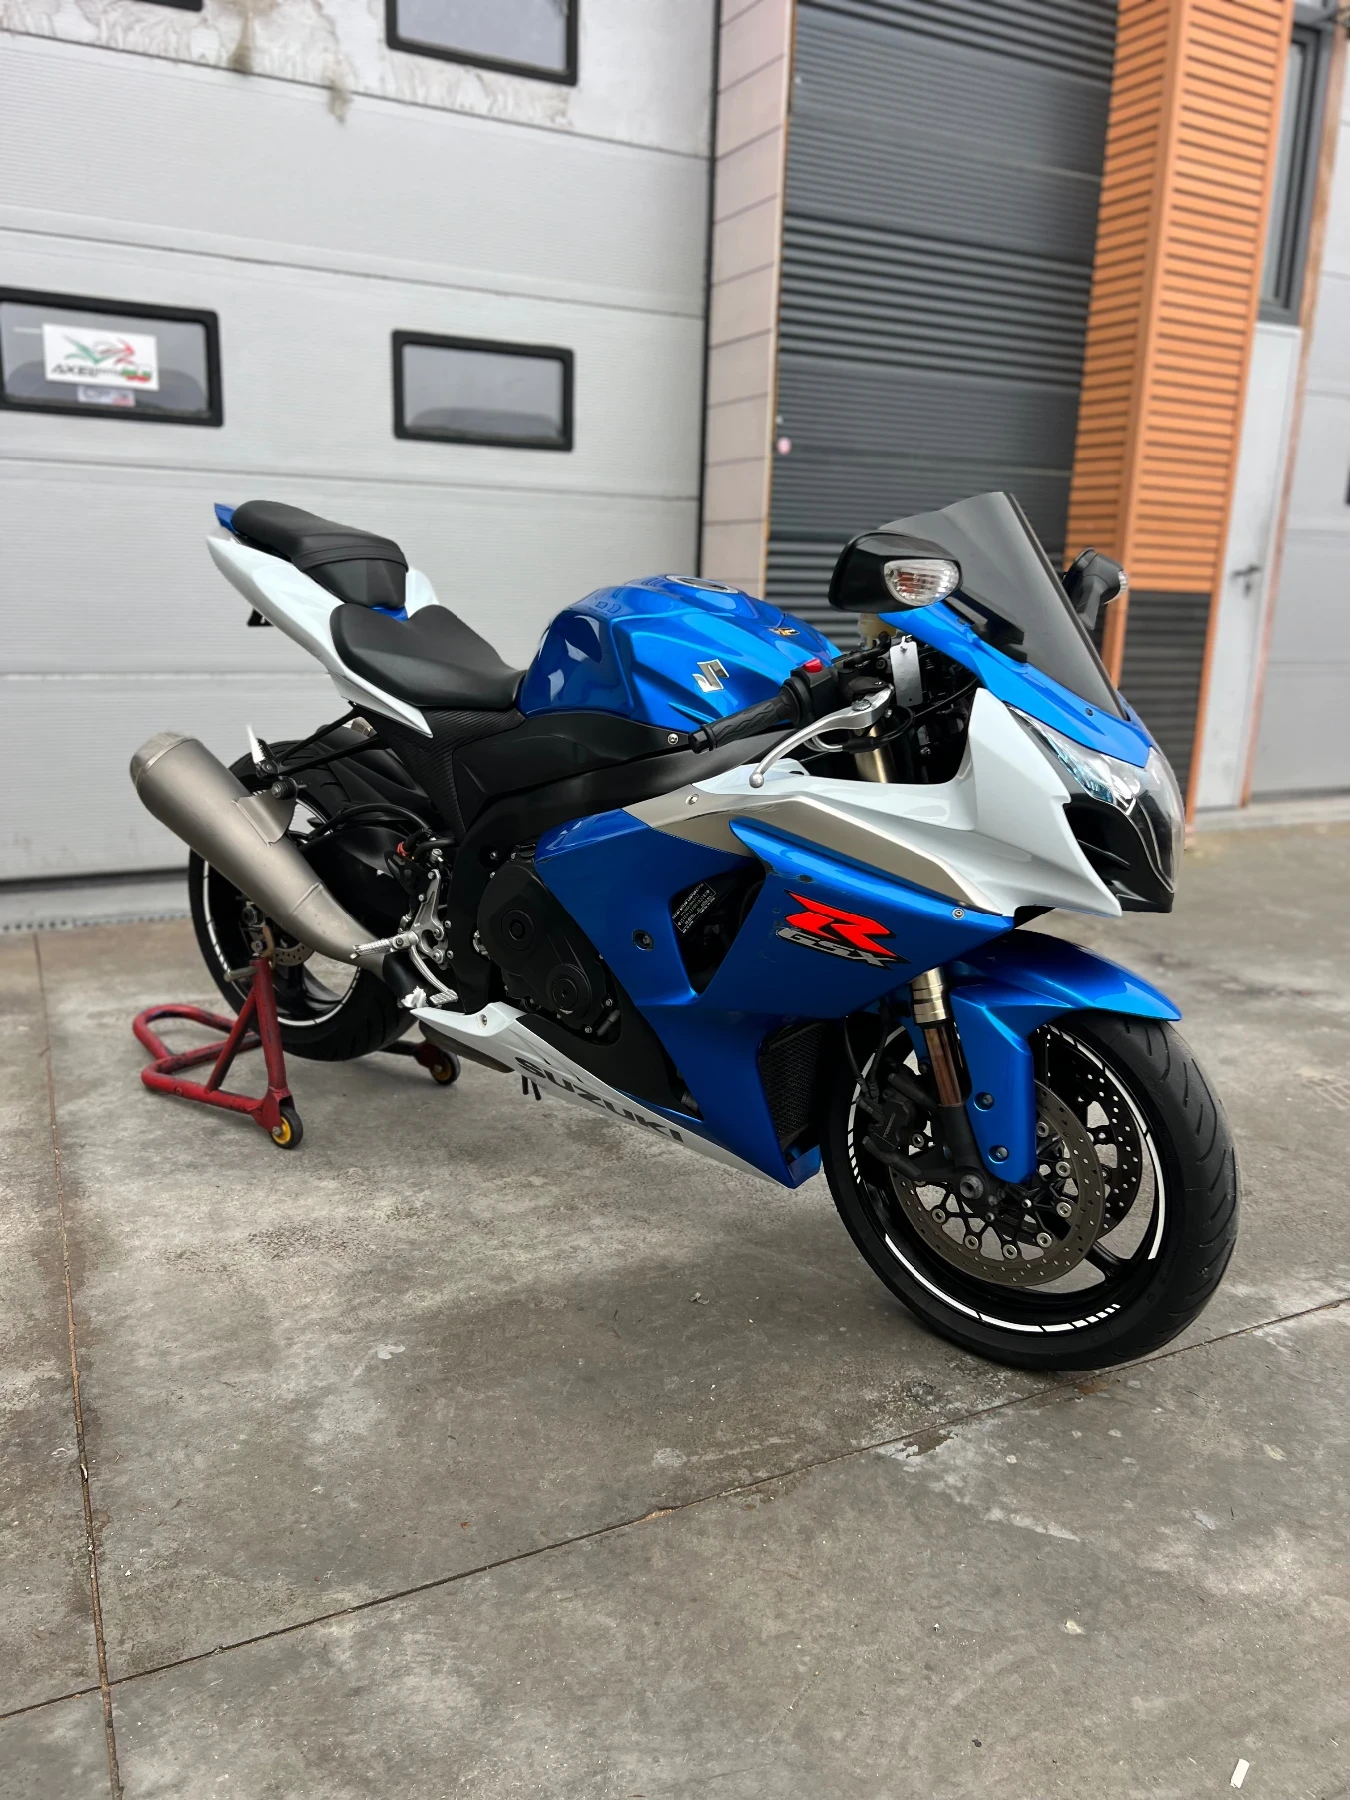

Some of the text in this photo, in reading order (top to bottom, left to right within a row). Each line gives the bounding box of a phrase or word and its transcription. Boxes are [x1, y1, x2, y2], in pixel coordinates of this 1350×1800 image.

[776, 928, 897, 967] GSX
[784, 889, 900, 958] R
[515, 1056, 684, 1143] SUZUKI
